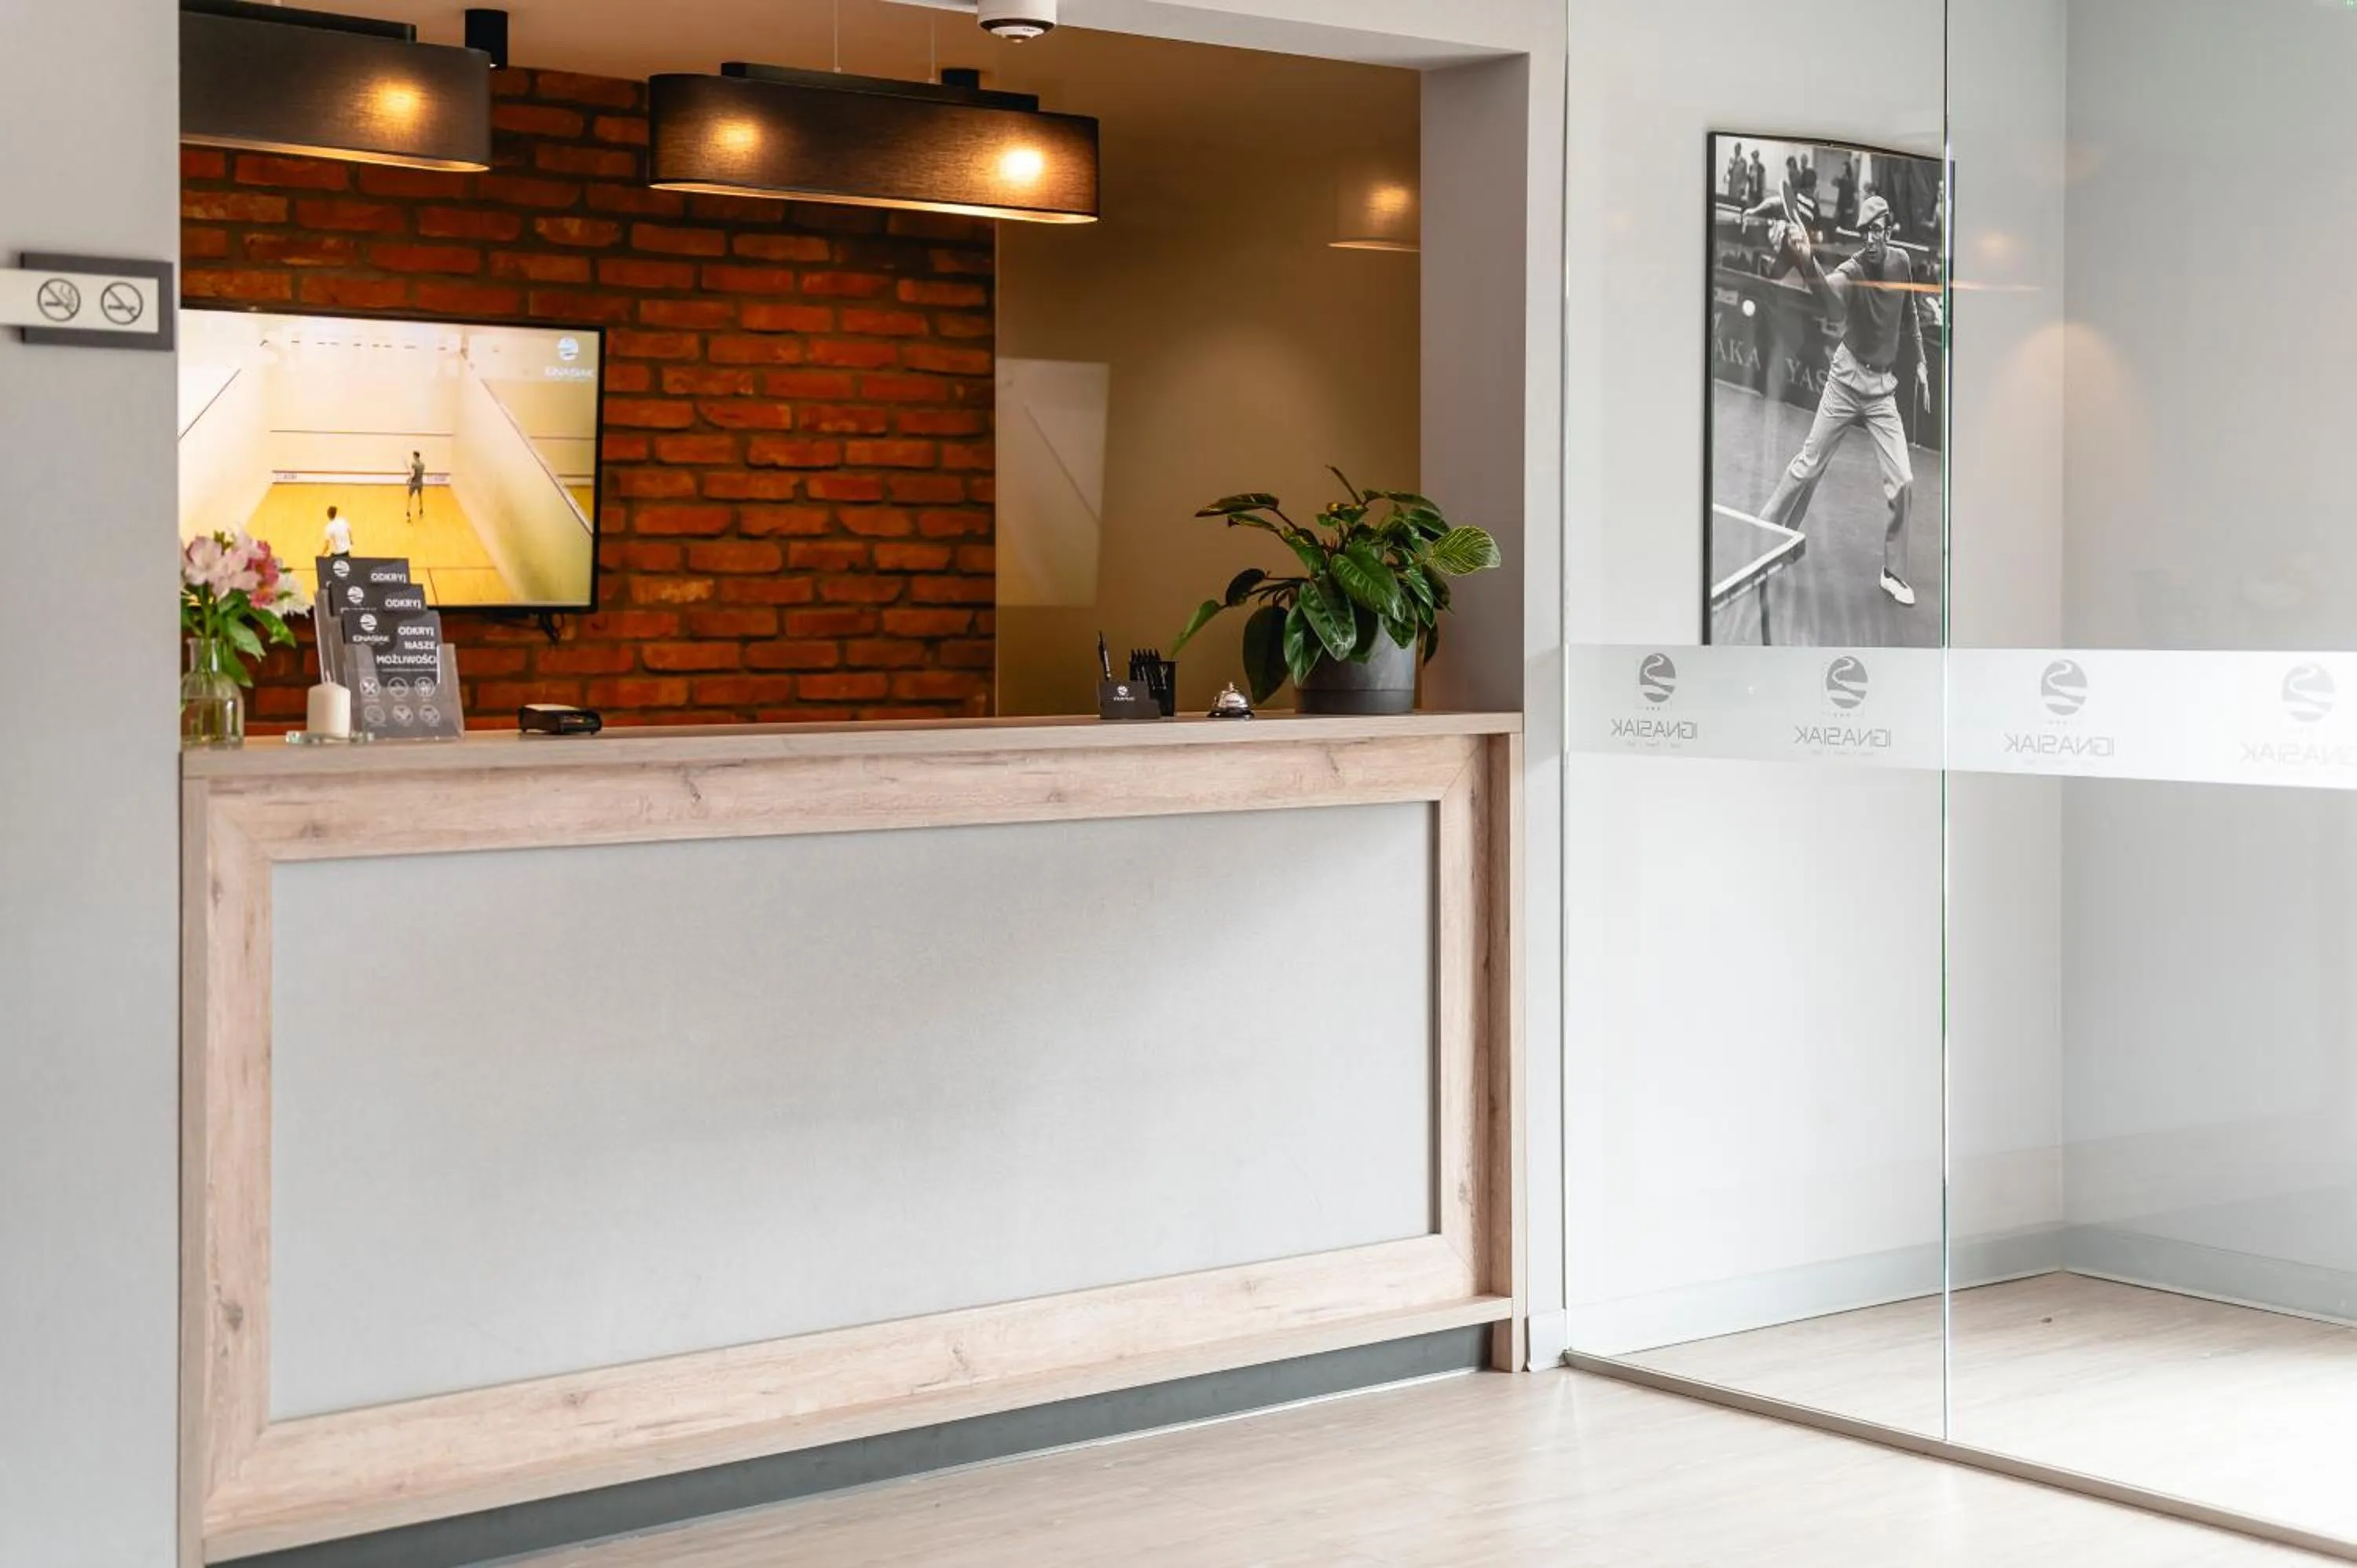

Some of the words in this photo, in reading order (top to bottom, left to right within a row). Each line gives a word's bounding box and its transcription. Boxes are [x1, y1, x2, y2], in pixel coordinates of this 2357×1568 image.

[370, 573, 407, 583] ODKRYJ
[384, 599, 422, 609] ODKRYJ
[397, 626, 435, 636] ODKRYJ
[403, 640, 436, 650] NASZE
